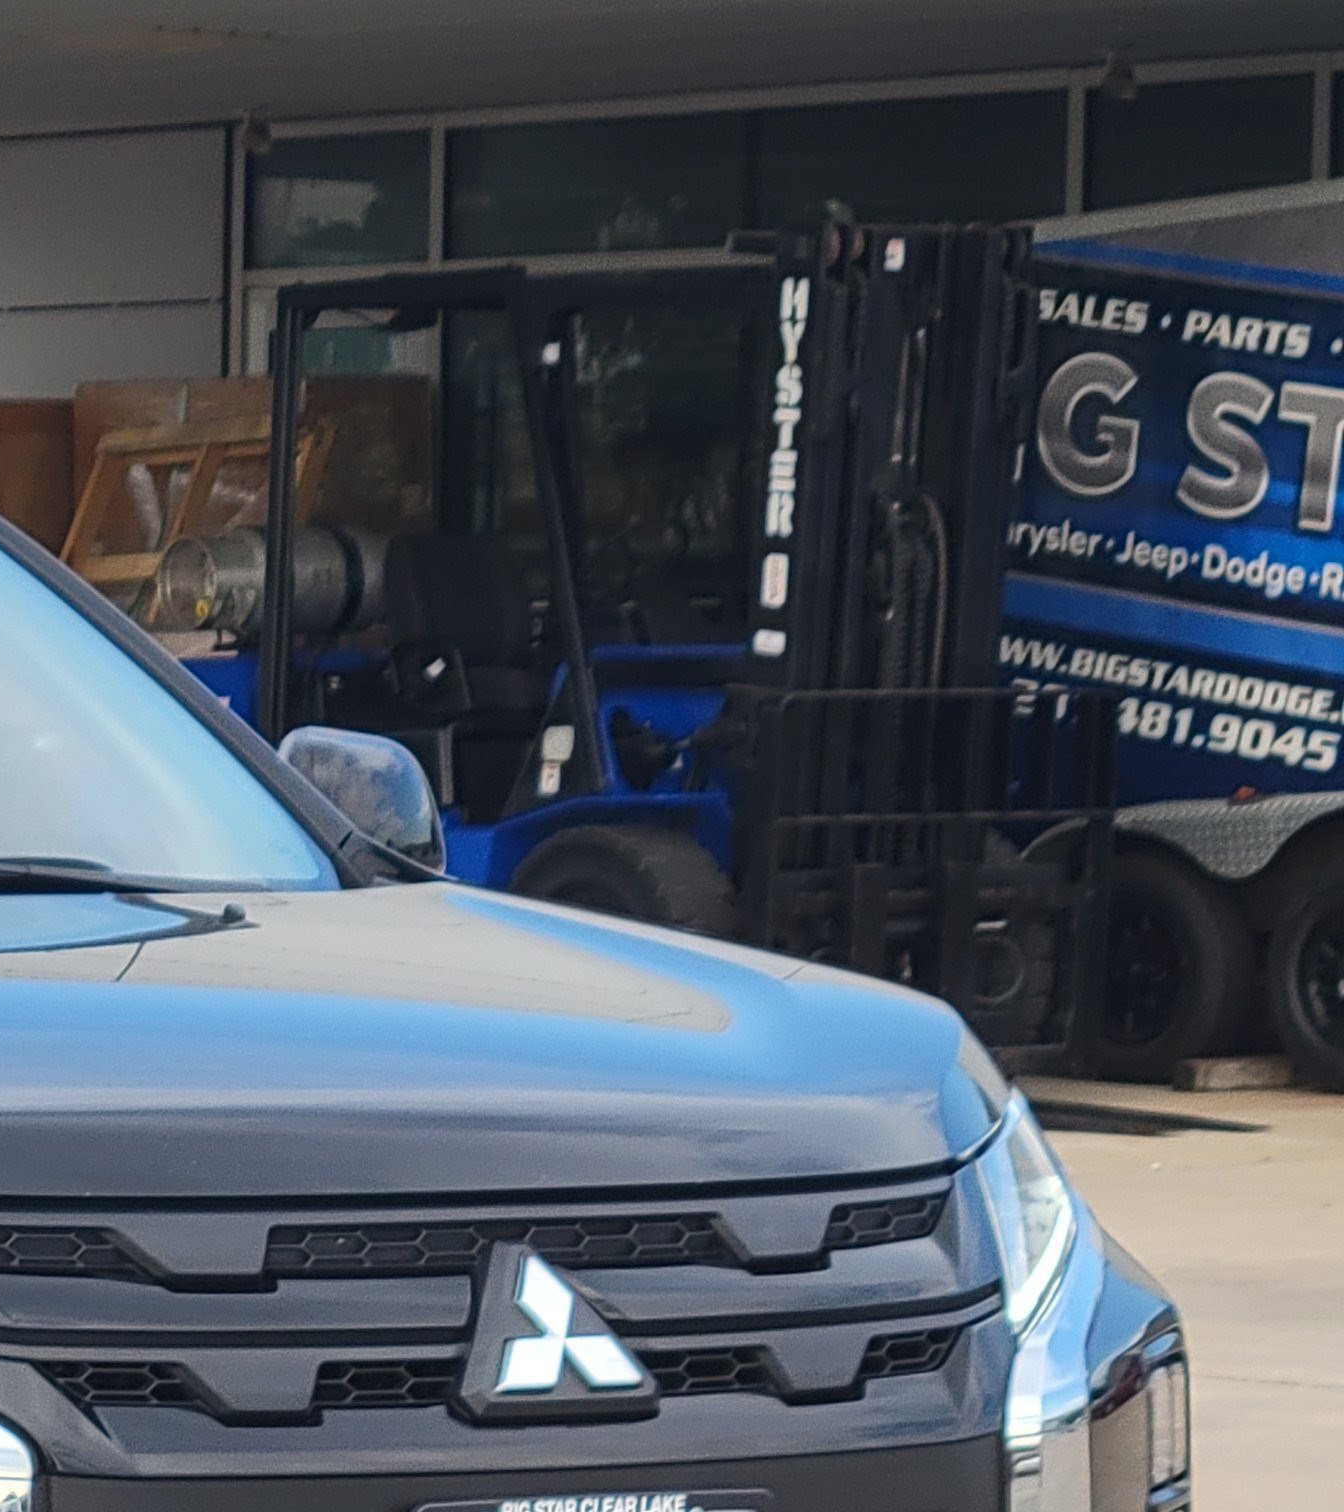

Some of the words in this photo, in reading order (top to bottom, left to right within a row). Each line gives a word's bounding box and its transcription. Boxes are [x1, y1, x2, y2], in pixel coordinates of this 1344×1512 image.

[1039, 289, 1150, 333] SALES
[1182, 311, 1311, 358] PARTS
[765, 277, 810, 537] HYSTER
[1116, 531, 1188, 579] Jeep
[1202, 544, 1305, 599] Dodge
[1319, 562, 1344, 600] R
